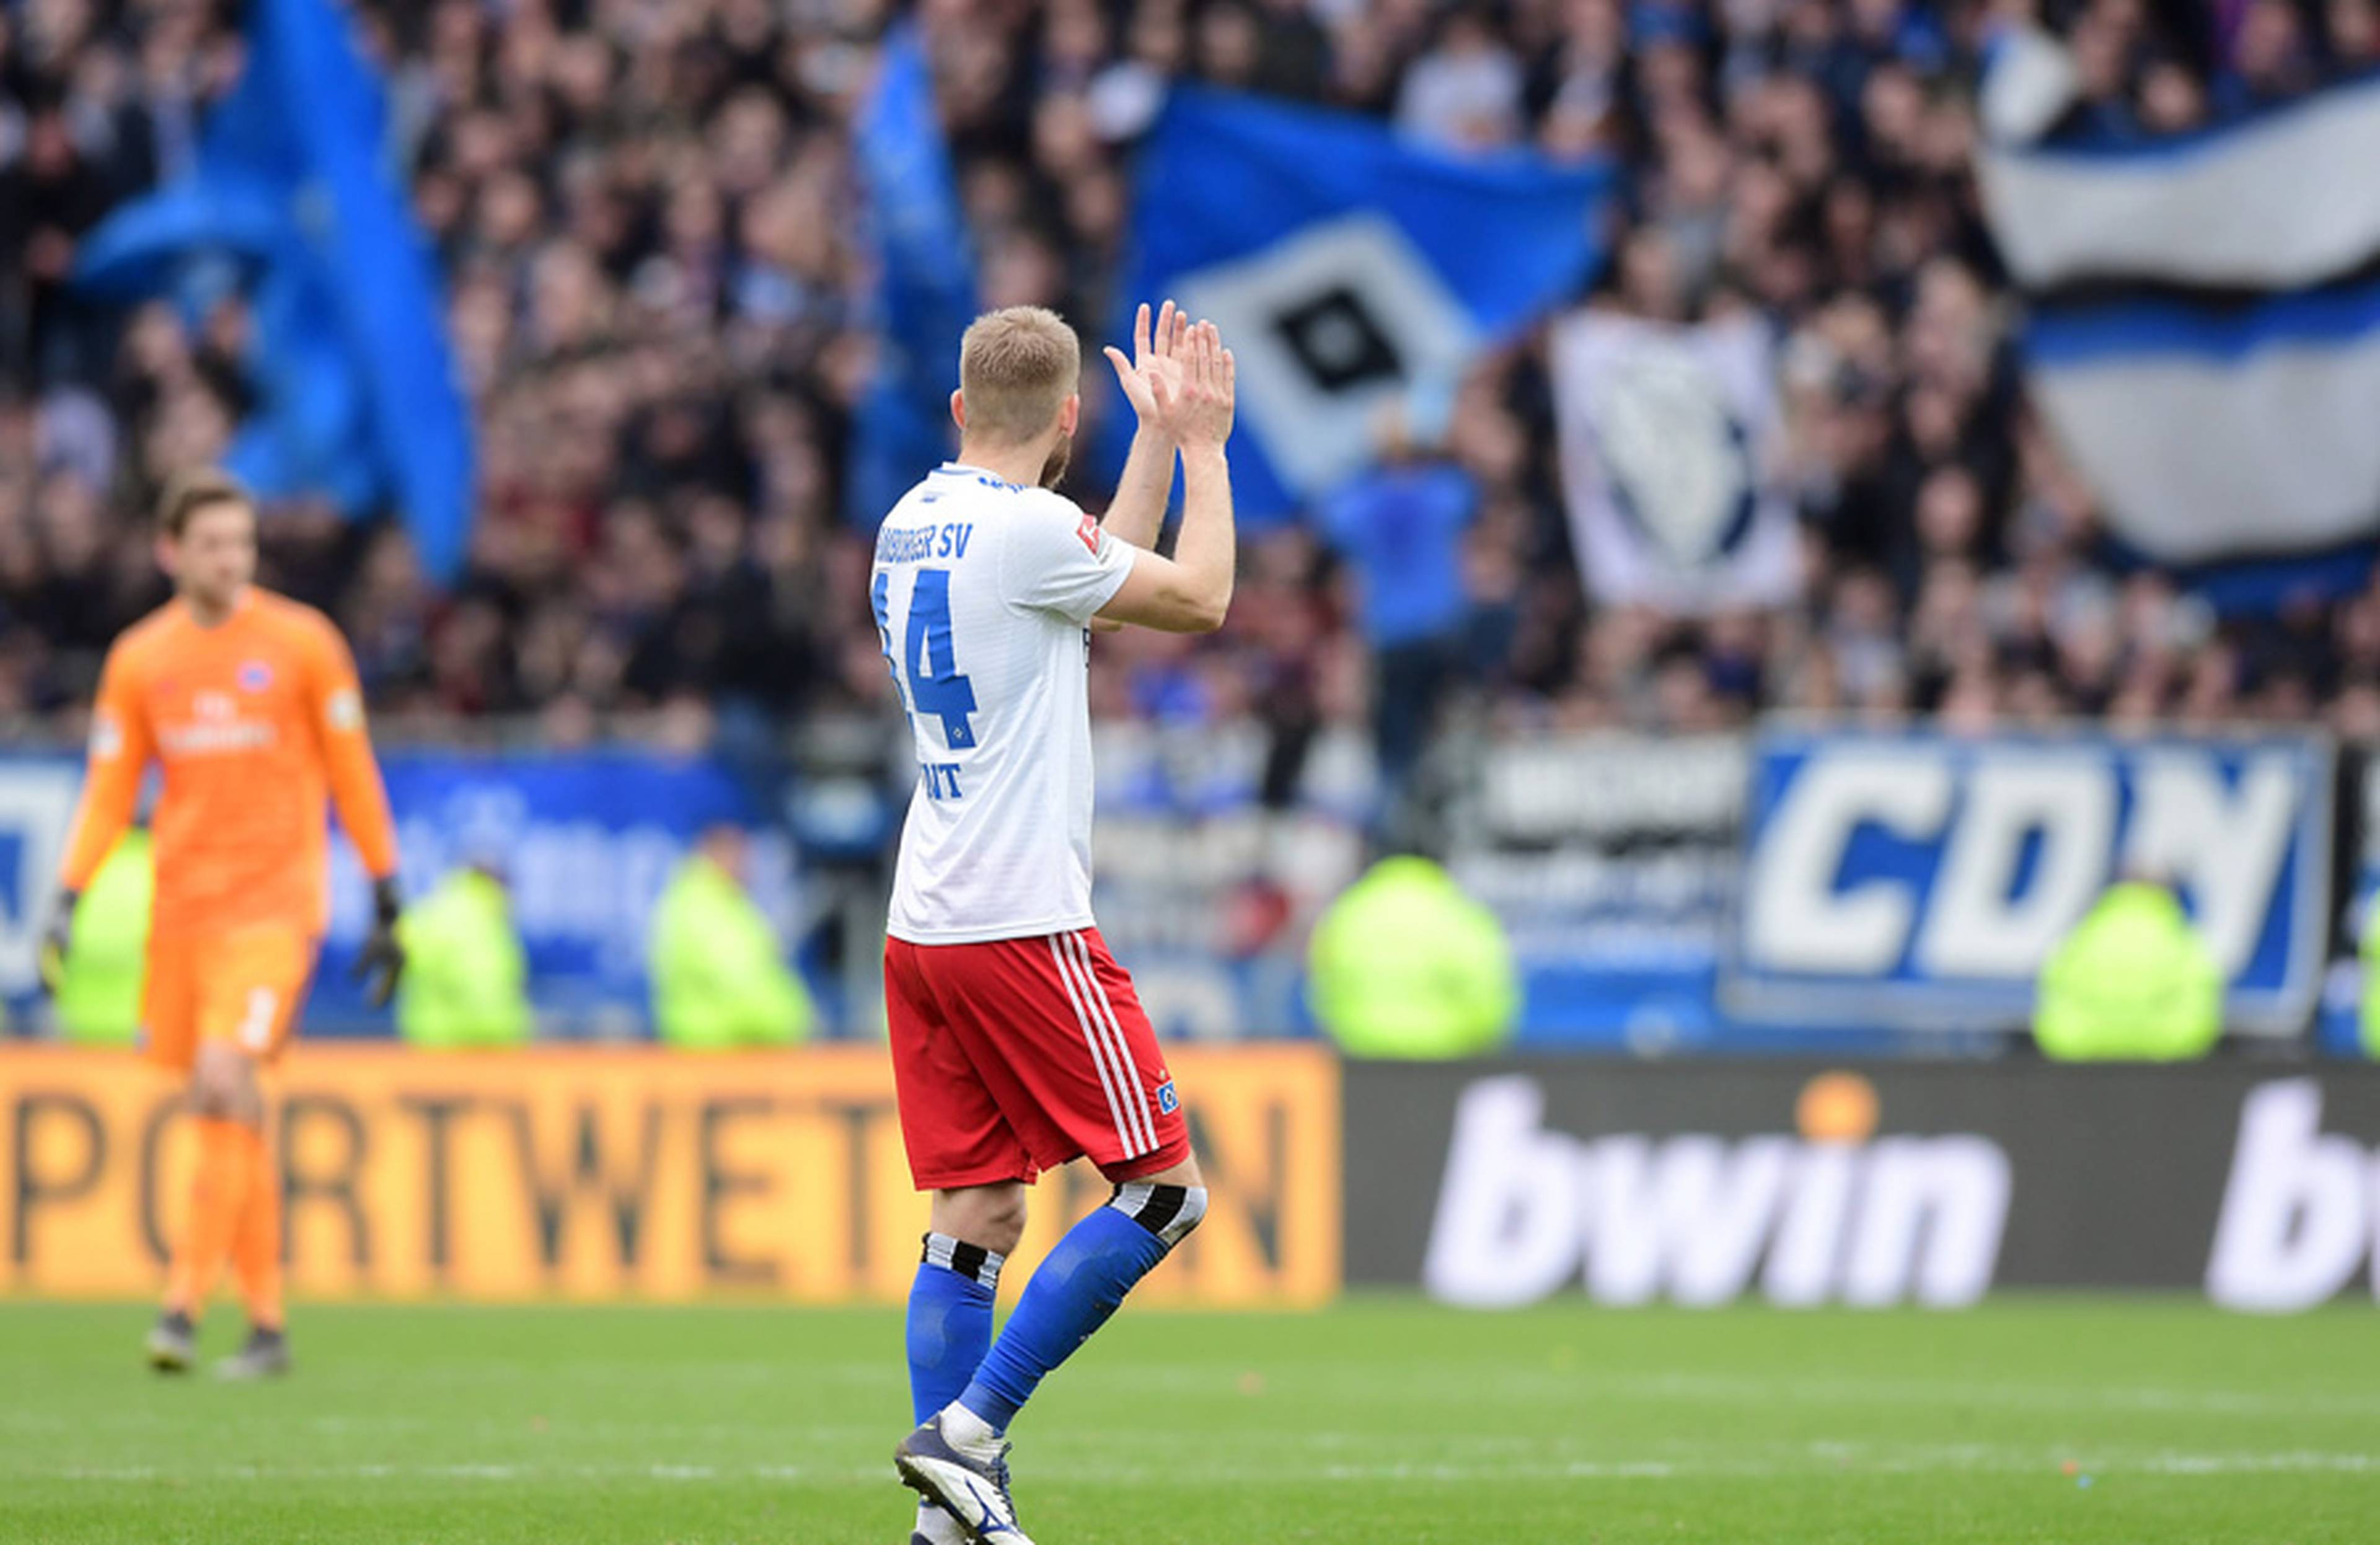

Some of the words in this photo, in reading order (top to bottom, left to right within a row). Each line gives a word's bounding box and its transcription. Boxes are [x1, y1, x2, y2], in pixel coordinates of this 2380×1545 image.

[938, 523, 974, 559] SV
[1424, 1071, 2013, 1309] bwin
[2205, 1076, 2380, 1313] b
